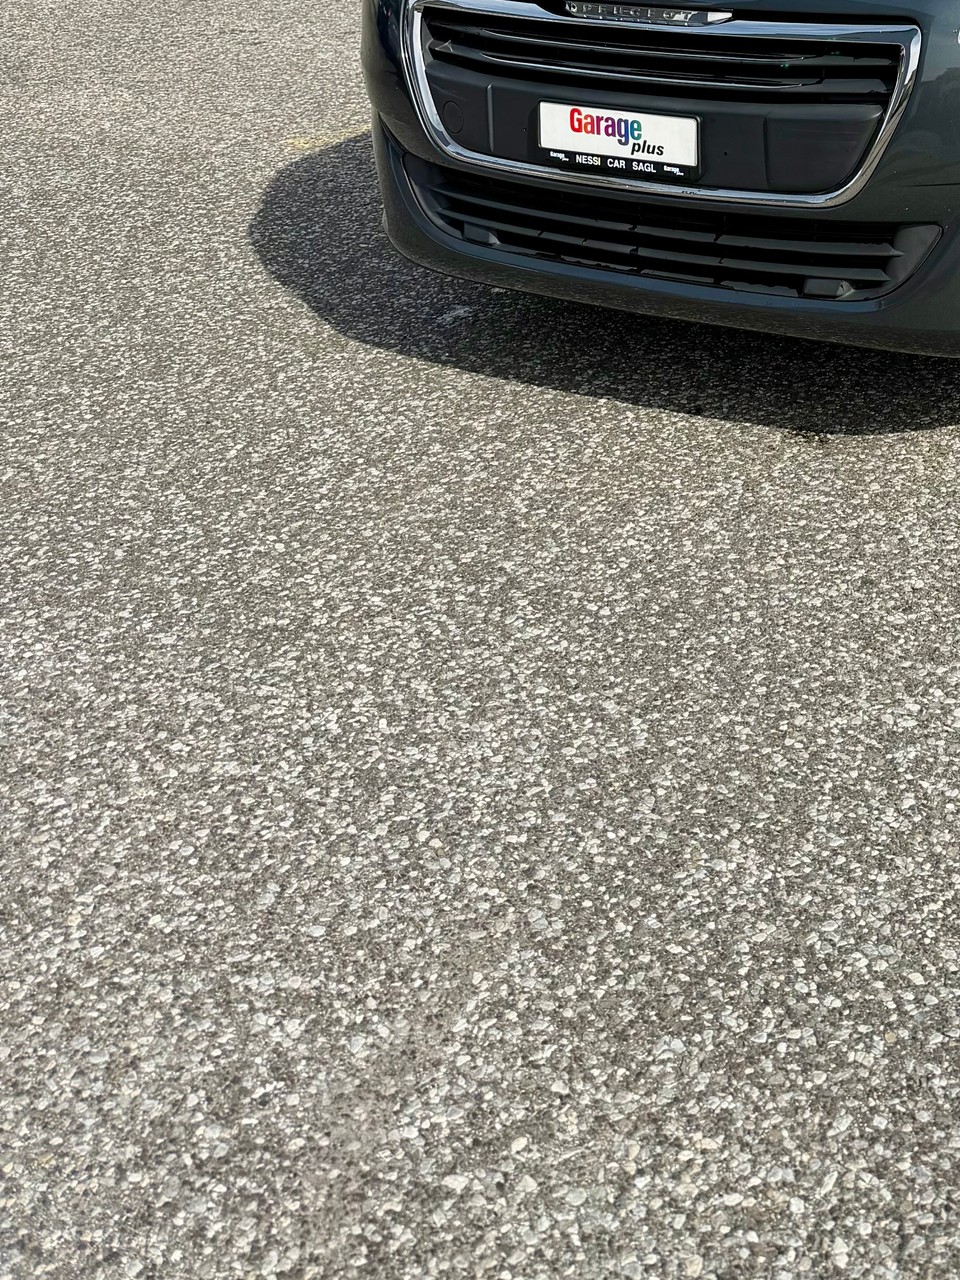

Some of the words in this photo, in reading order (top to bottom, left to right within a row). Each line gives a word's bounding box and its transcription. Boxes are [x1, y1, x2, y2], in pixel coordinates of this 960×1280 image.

[569, 107, 642, 146] Garage
[631, 140, 665, 156] plus
[575, 155, 601, 166] NESSI
[607, 158, 626, 169] CAR
[632, 162, 657, 173] SAGL
